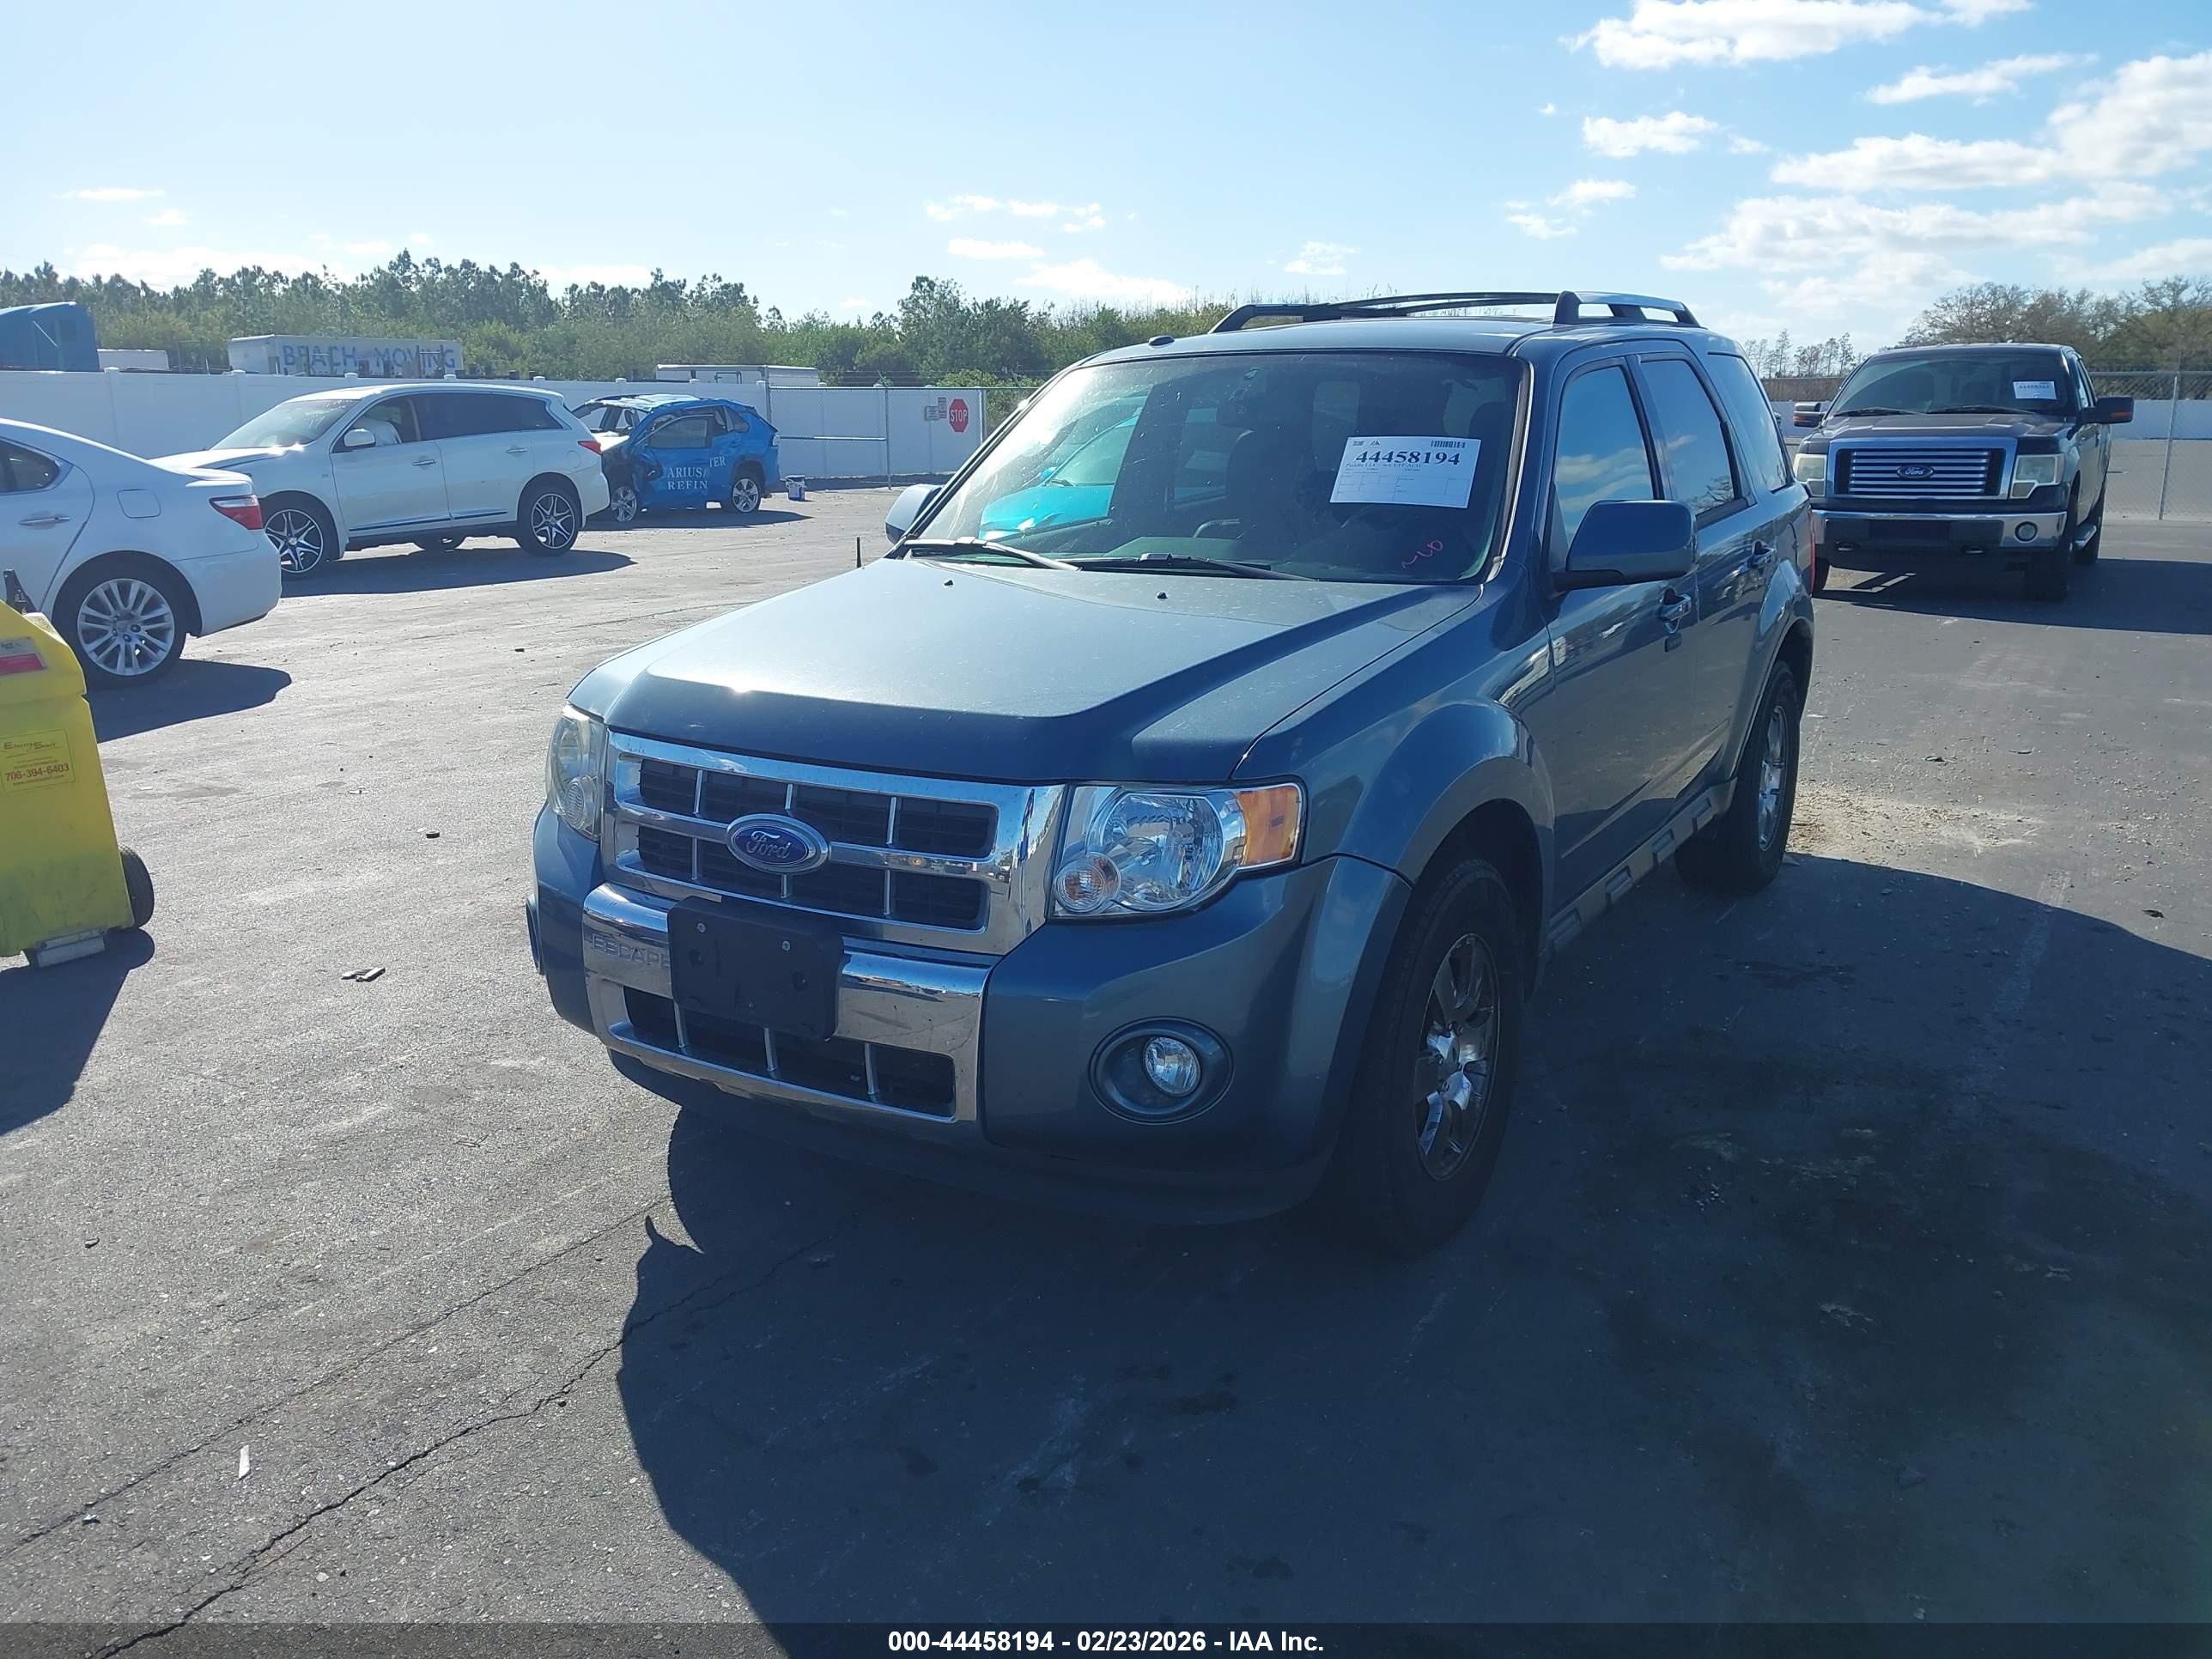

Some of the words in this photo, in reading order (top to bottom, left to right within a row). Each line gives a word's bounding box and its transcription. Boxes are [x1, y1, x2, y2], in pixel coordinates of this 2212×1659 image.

[951, 409, 968, 422] STOP
[1355, 450, 1461, 466] 44458194
[663, 466, 702, 478] ARIUS
[667, 480, 708, 490] REFIN
[745, 830, 792, 859] Ford
